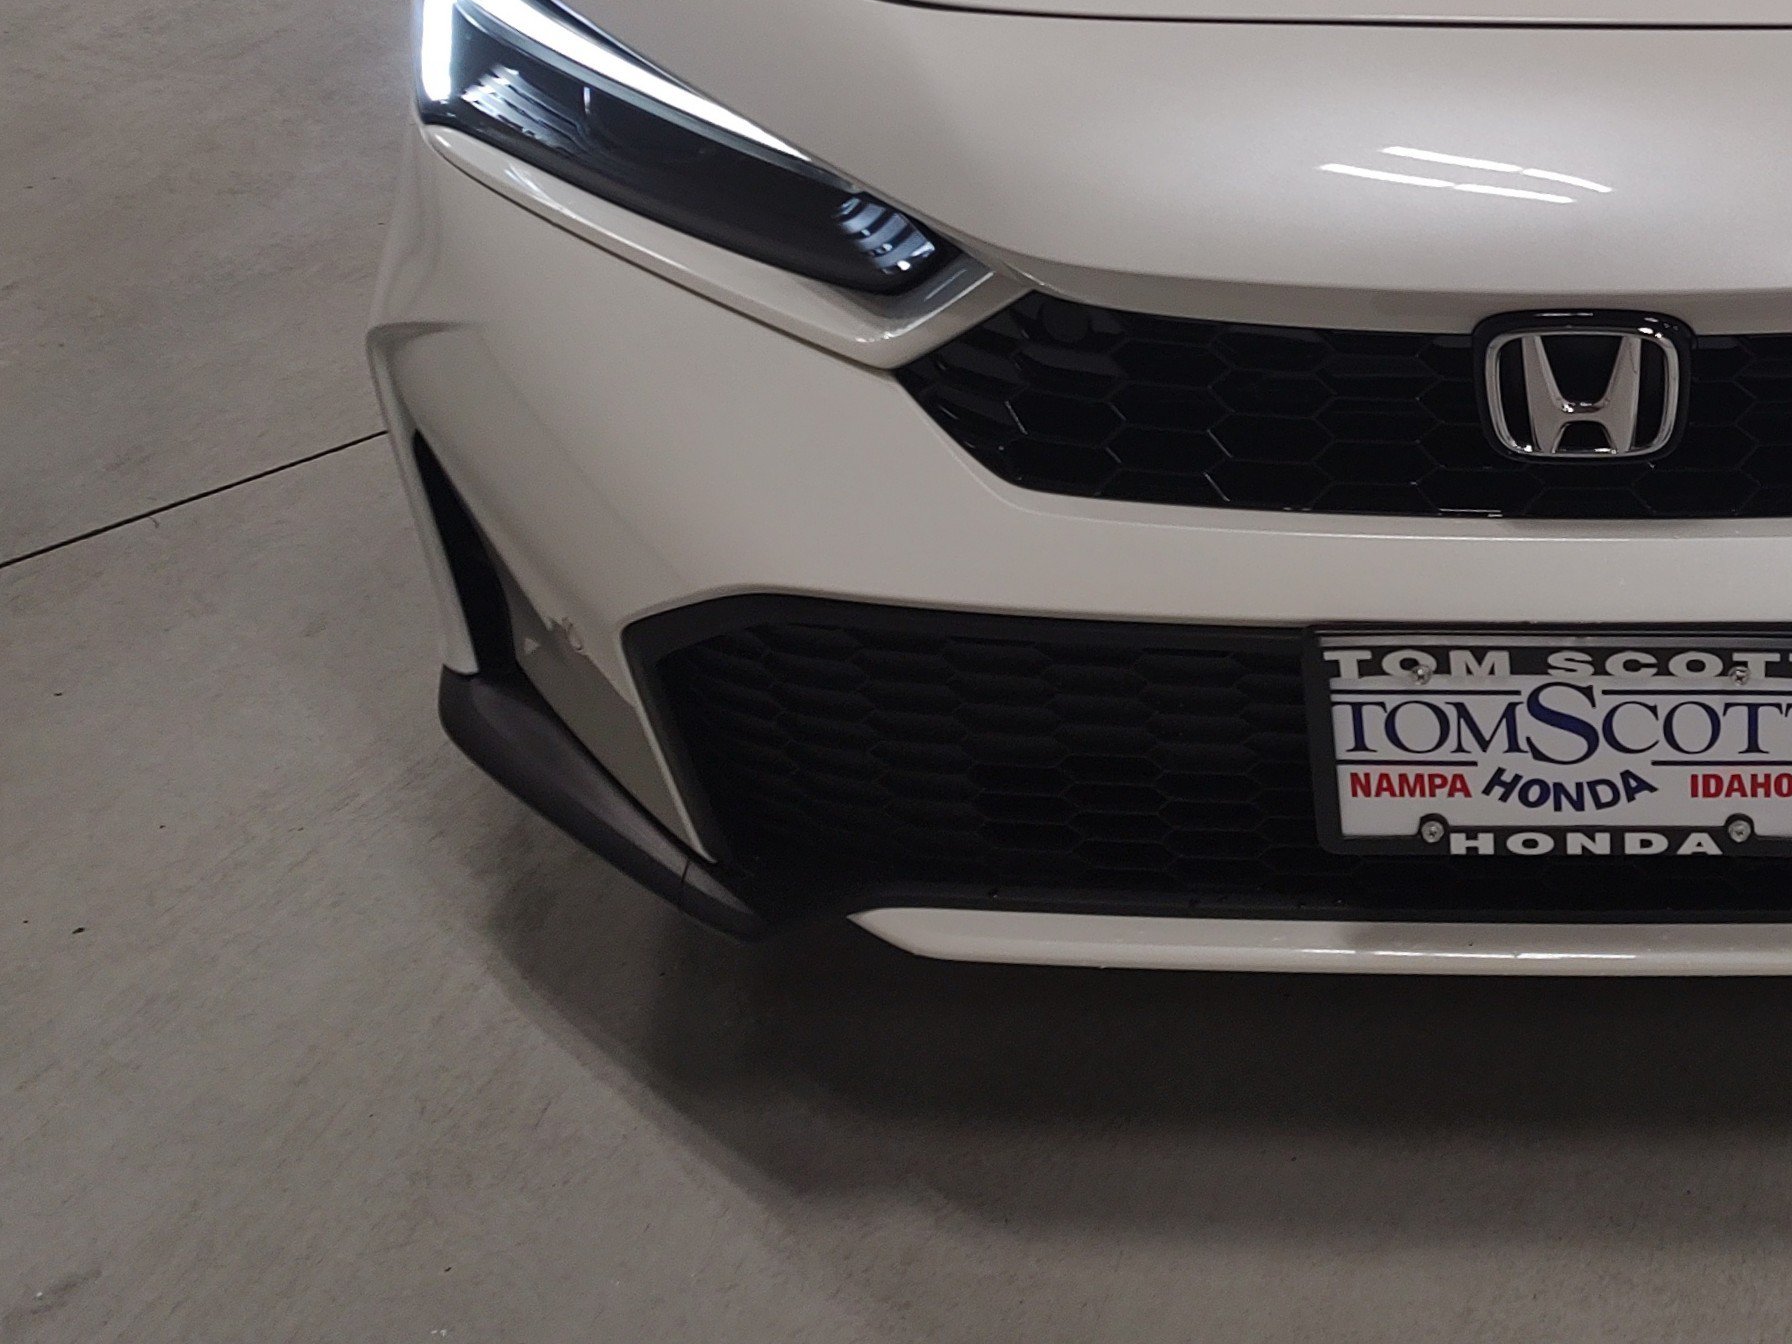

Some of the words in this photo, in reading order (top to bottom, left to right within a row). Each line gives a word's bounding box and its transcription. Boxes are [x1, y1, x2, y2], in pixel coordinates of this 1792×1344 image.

[1323, 649, 1510, 681] TOM
[1349, 772, 1472, 798] NAMPA
[1481, 767, 1658, 812] HONDA
[1449, 832, 1723, 855] HONDA
